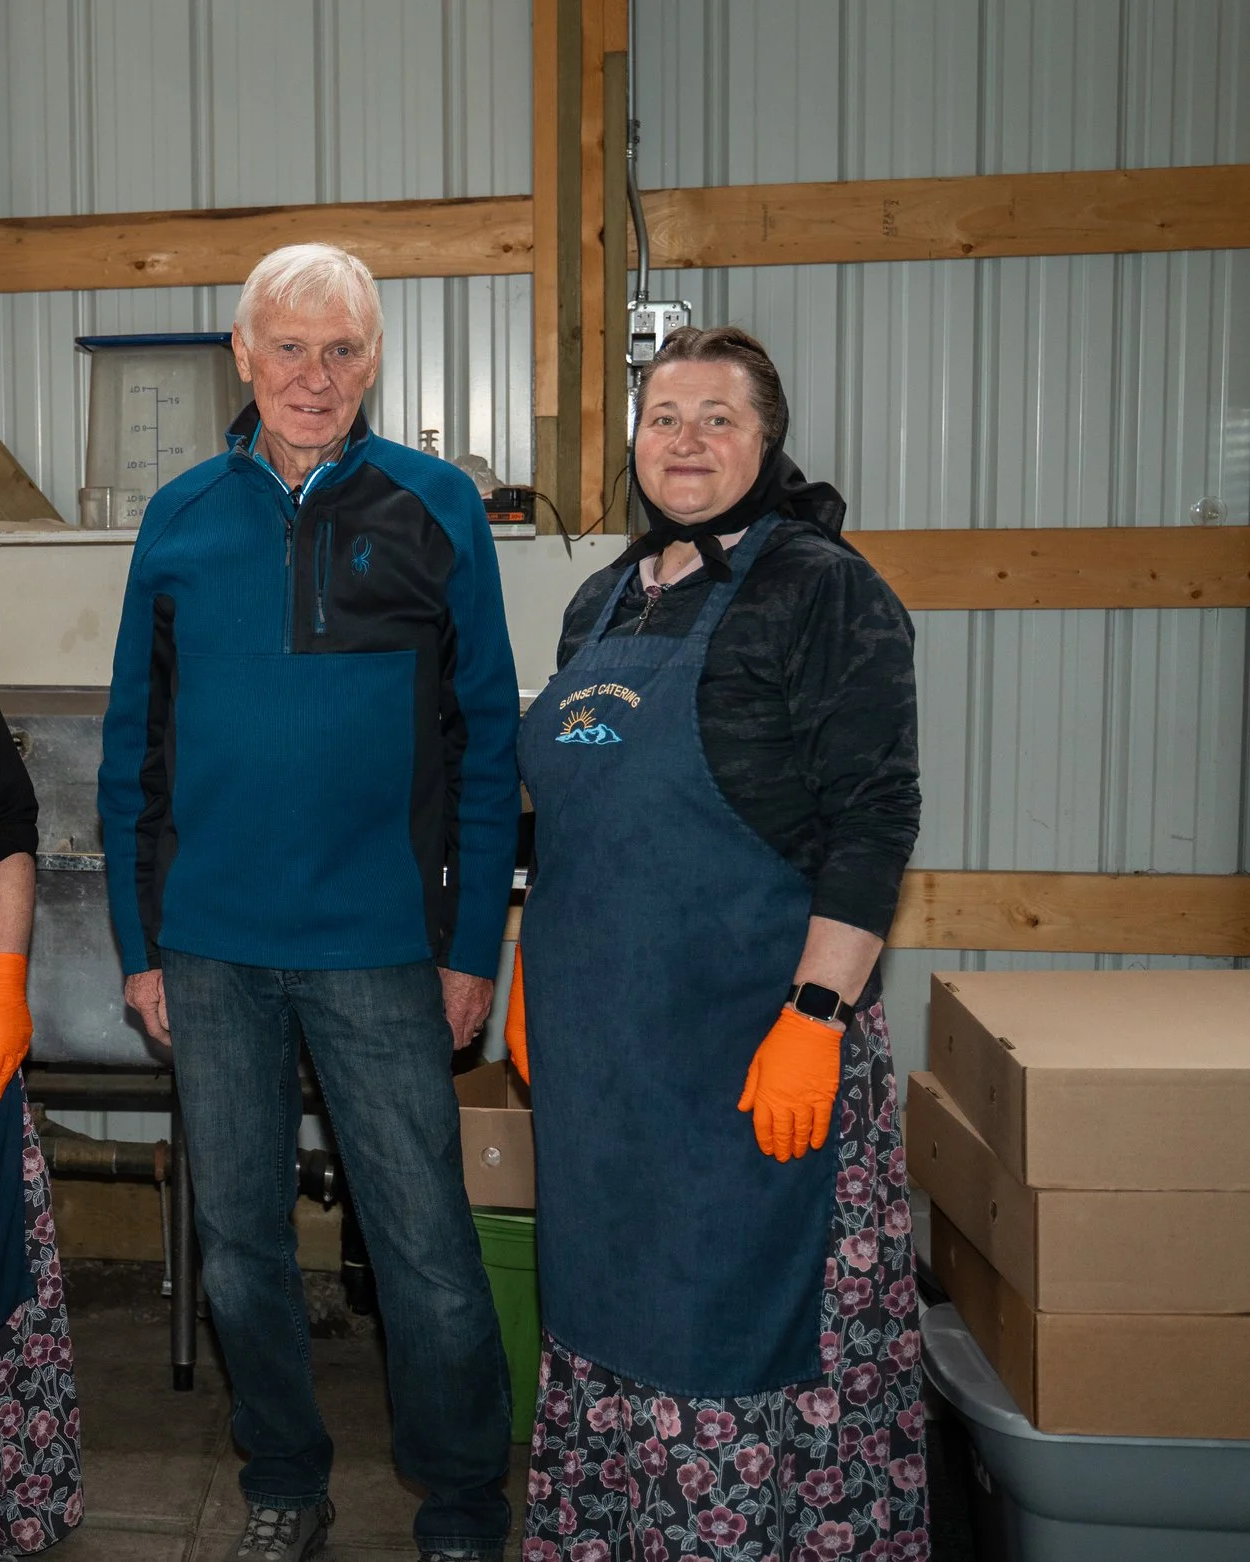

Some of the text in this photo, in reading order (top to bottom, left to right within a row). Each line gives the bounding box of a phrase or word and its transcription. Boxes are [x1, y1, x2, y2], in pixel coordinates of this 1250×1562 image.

[127, 461, 137, 469] QT
[559, 683, 640, 710] SUNSET CATERING
